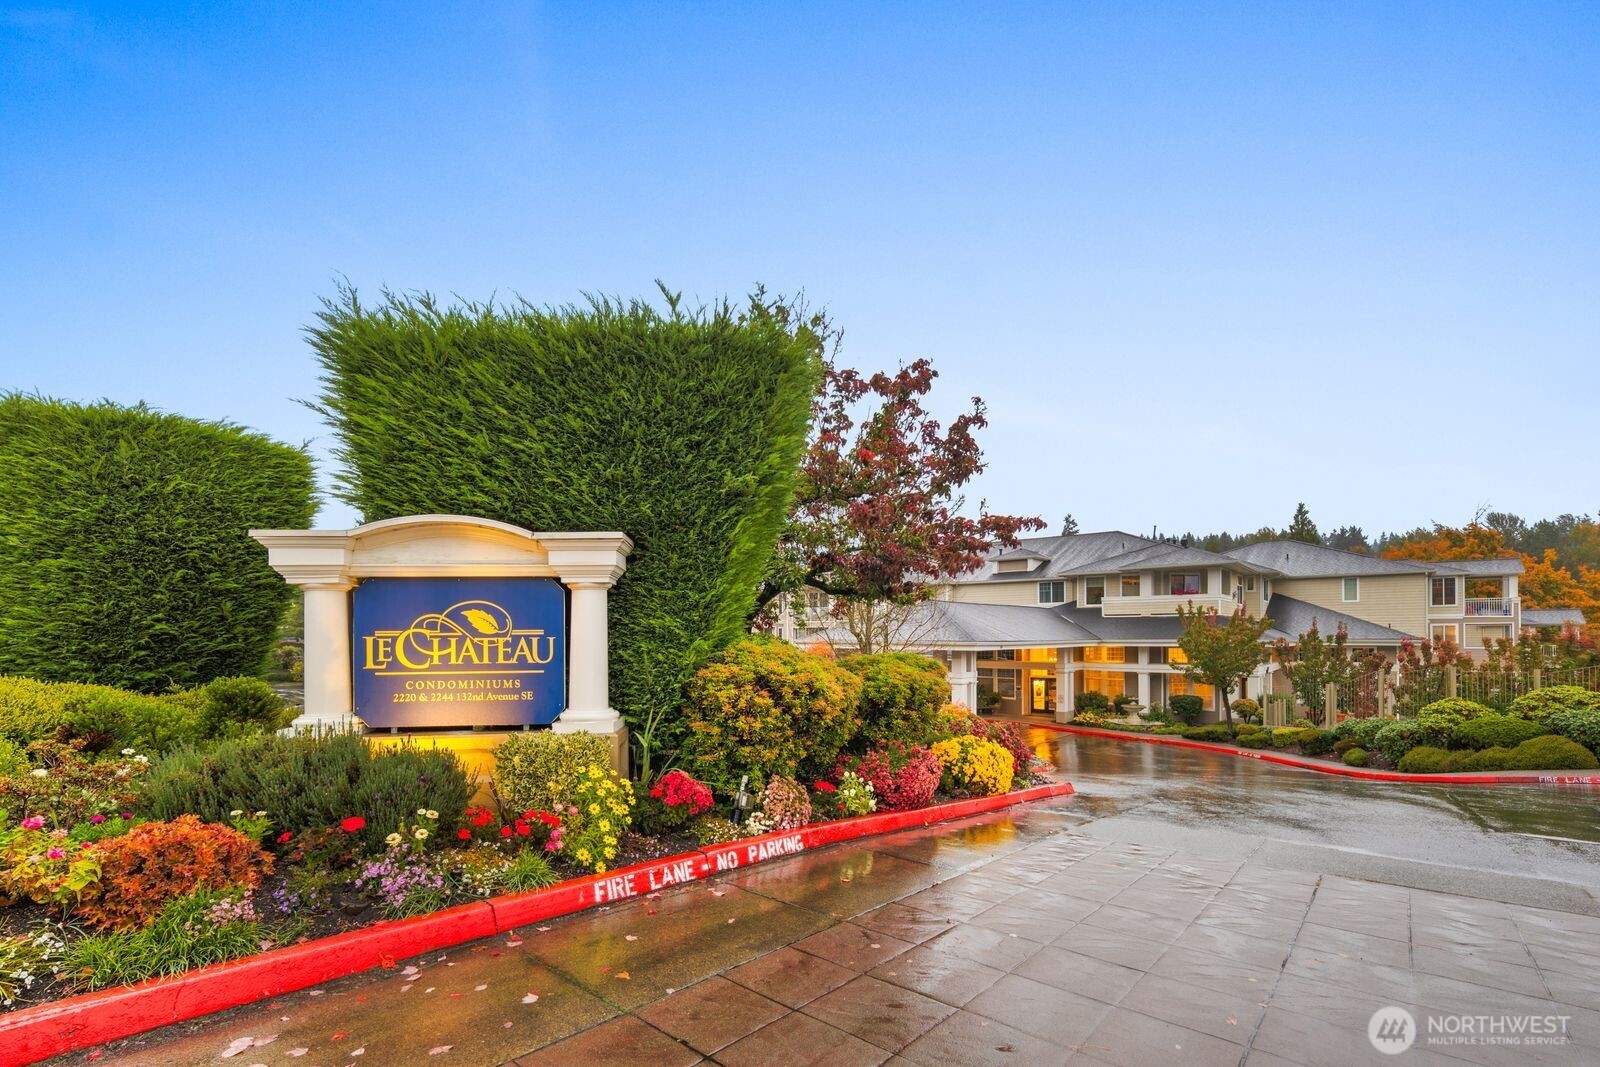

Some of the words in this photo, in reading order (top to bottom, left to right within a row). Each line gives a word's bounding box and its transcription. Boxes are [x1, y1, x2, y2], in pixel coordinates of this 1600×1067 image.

[405, 680, 521, 690] CONDOMINIUMS
[393, 693, 417, 703] 2220
[418, 692, 429, 702] &
[430, 692, 454, 702] 2244
[456, 692, 485, 701] 132nd
[486, 692, 520, 701] Avenue
[520, 691, 534, 701] SE
[1565, 776, 1592, 784] LANE
[594, 874, 638, 903] FIRE
[649, 860, 697, 891] LANE
[717, 851, 738, 870] NO
[748, 835, 804, 863] PARKING
